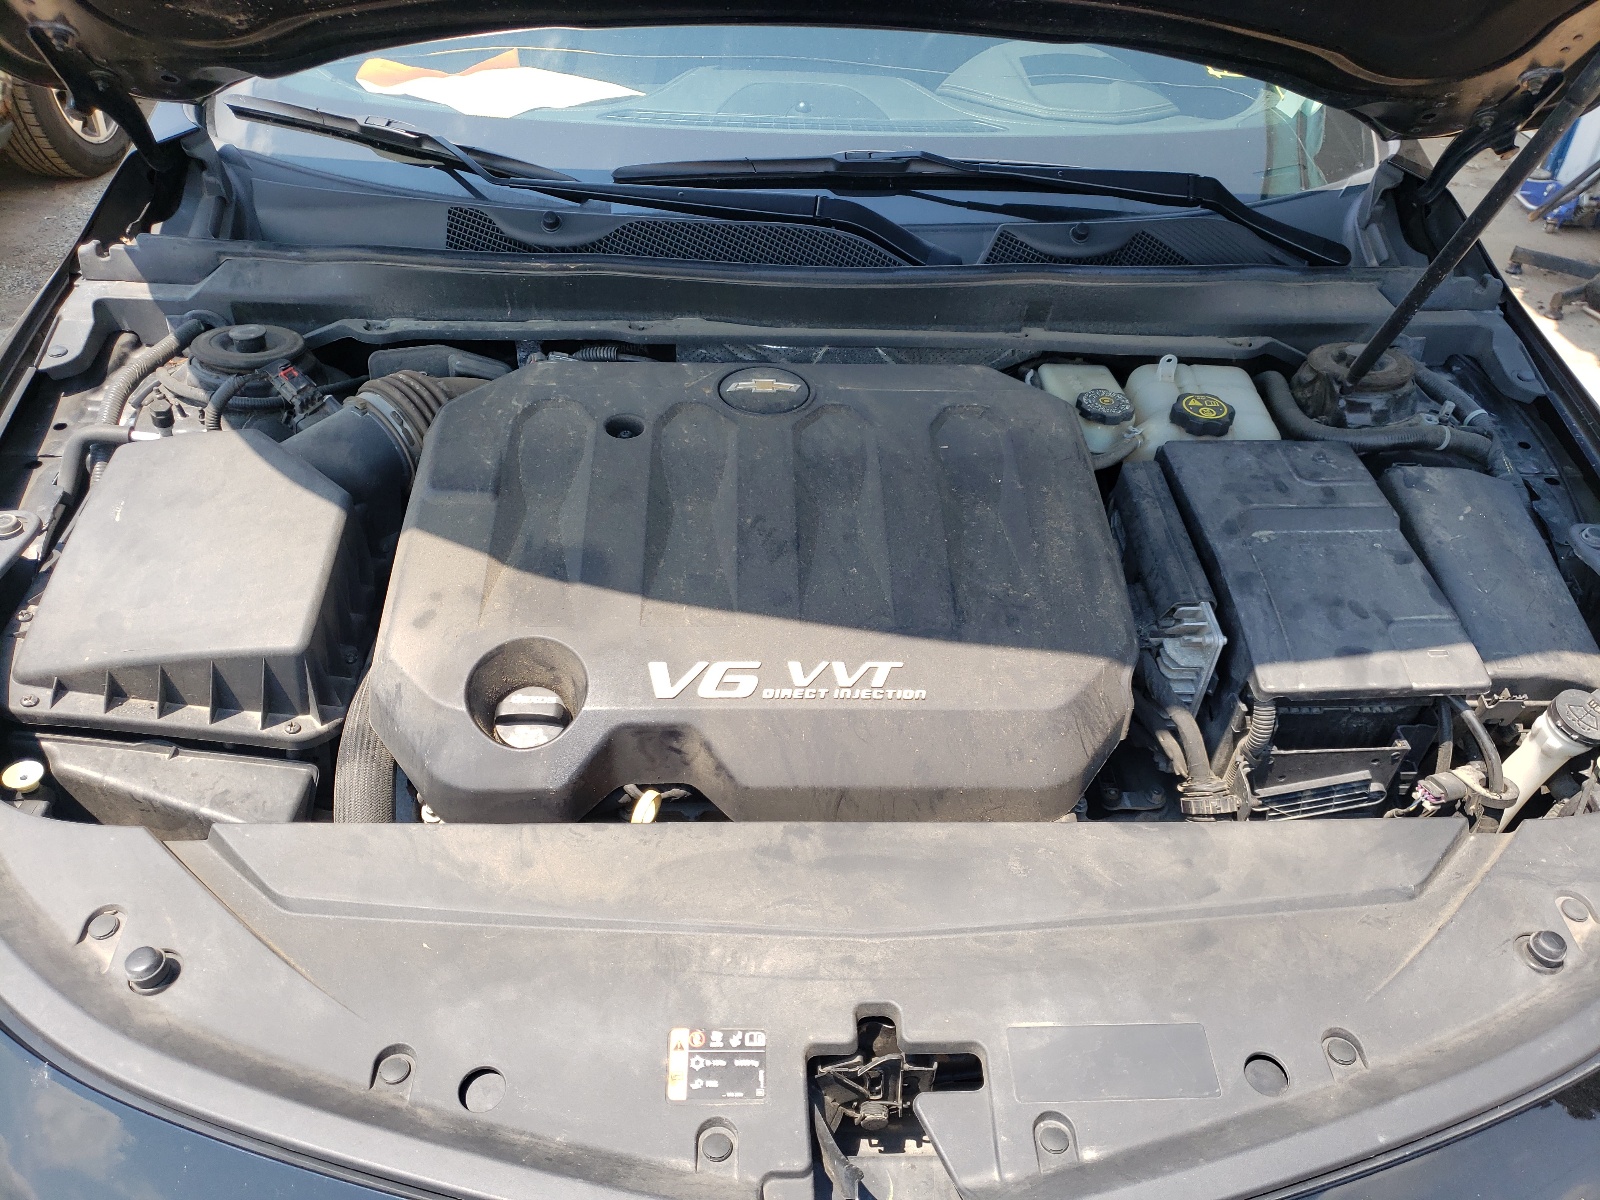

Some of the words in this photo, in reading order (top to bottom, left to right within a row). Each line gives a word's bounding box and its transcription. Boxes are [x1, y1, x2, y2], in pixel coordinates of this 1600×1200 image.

[648, 661, 762, 699] V6
[788, 661, 904, 688] VVT
[762, 688, 829, 700] DIRECT
[833, 688, 927, 700] INJECTION
